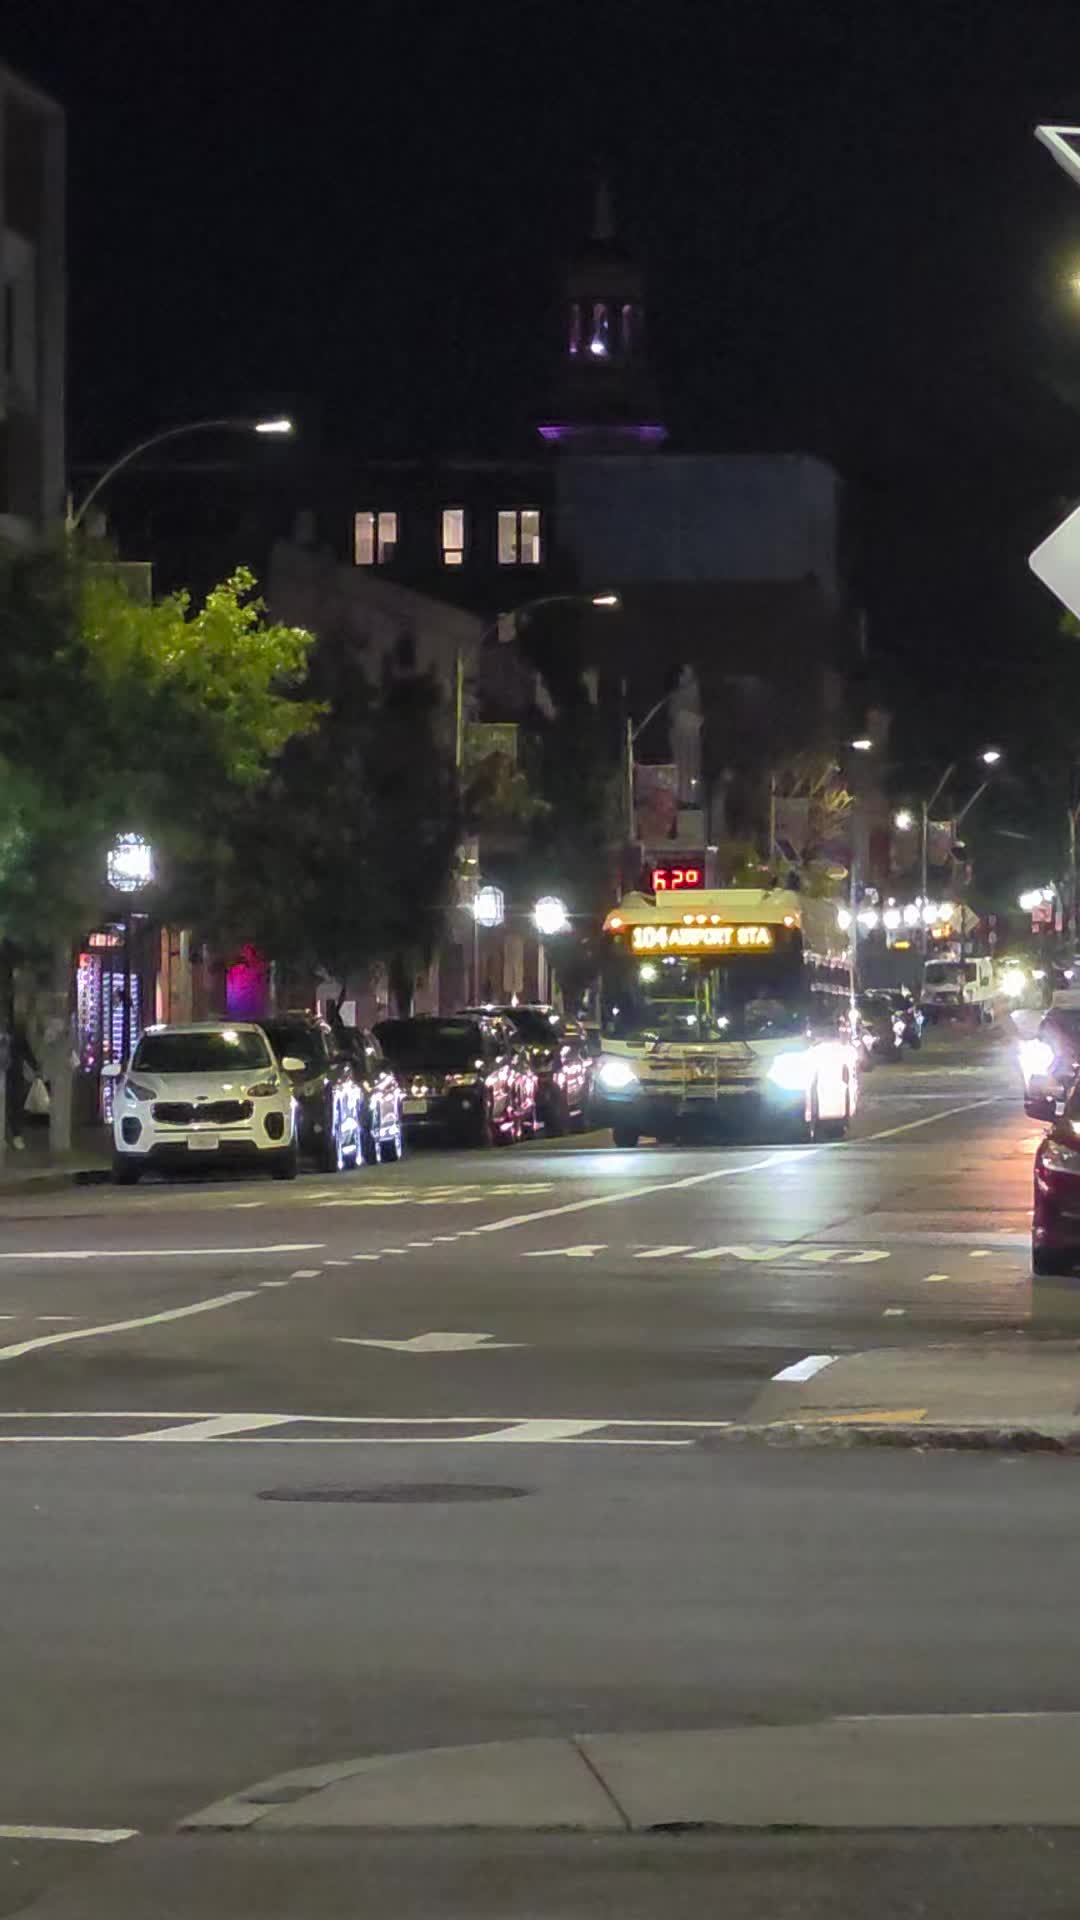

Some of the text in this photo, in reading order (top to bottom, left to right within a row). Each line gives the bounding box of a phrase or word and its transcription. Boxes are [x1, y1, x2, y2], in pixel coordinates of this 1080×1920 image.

[633, 927, 770, 949] 104 AIRPORT STA
[521, 1244, 891, 1263] ONLY
